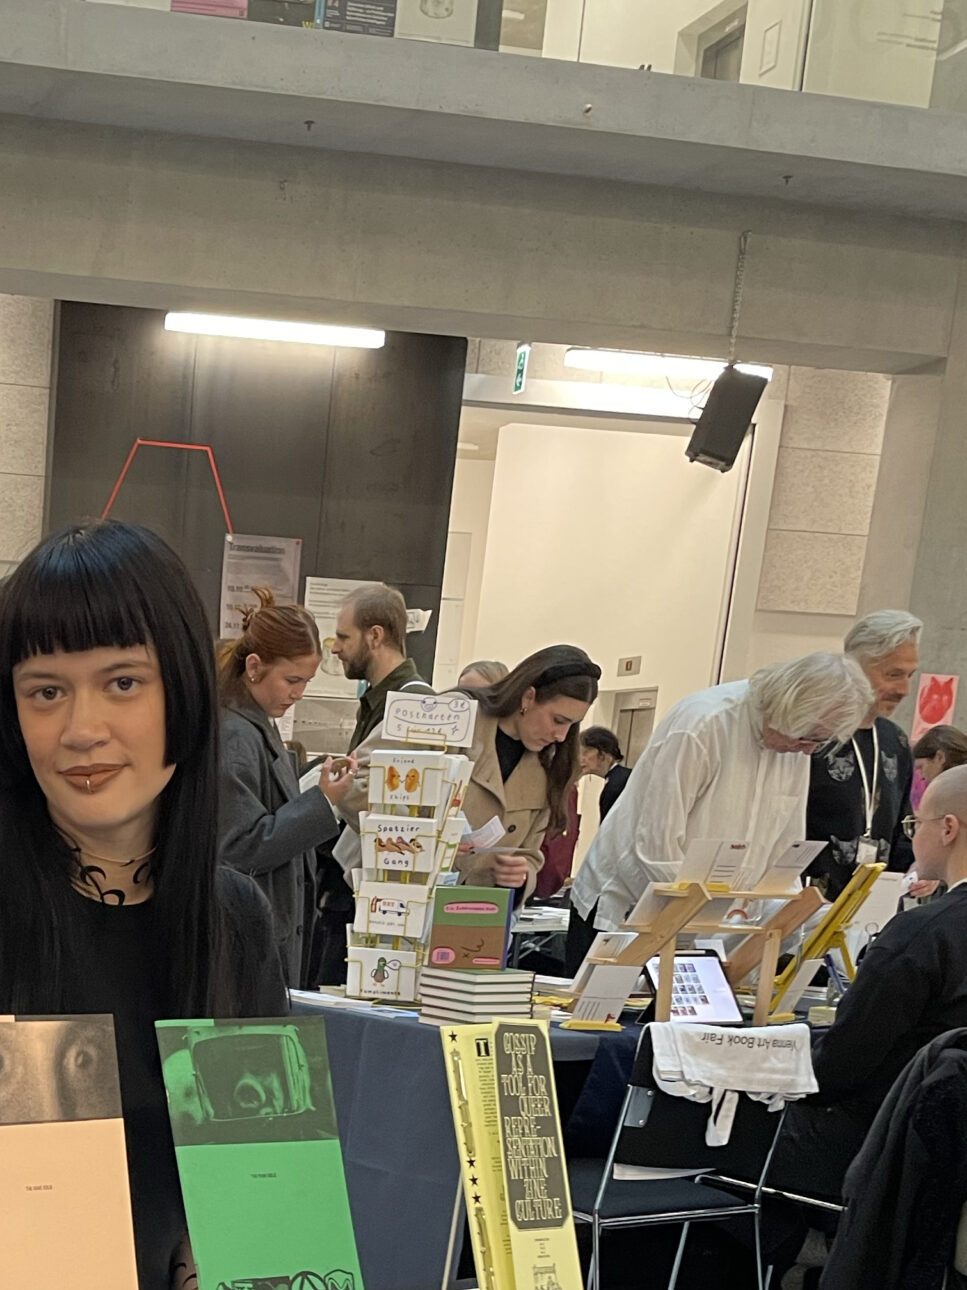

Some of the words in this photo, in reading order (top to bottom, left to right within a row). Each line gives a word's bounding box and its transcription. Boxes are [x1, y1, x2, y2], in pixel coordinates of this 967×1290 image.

[503, 1033, 537, 1054] GOSSIP
[701, 1032, 724, 1045] Fair
[728, 1034, 755, 1048] Book
[512, 1055, 524, 1075] AS
[526, 1054, 534, 1075] A
[519, 1096, 551, 1117] QUEER
[515, 1198, 562, 1221] CULTURE
